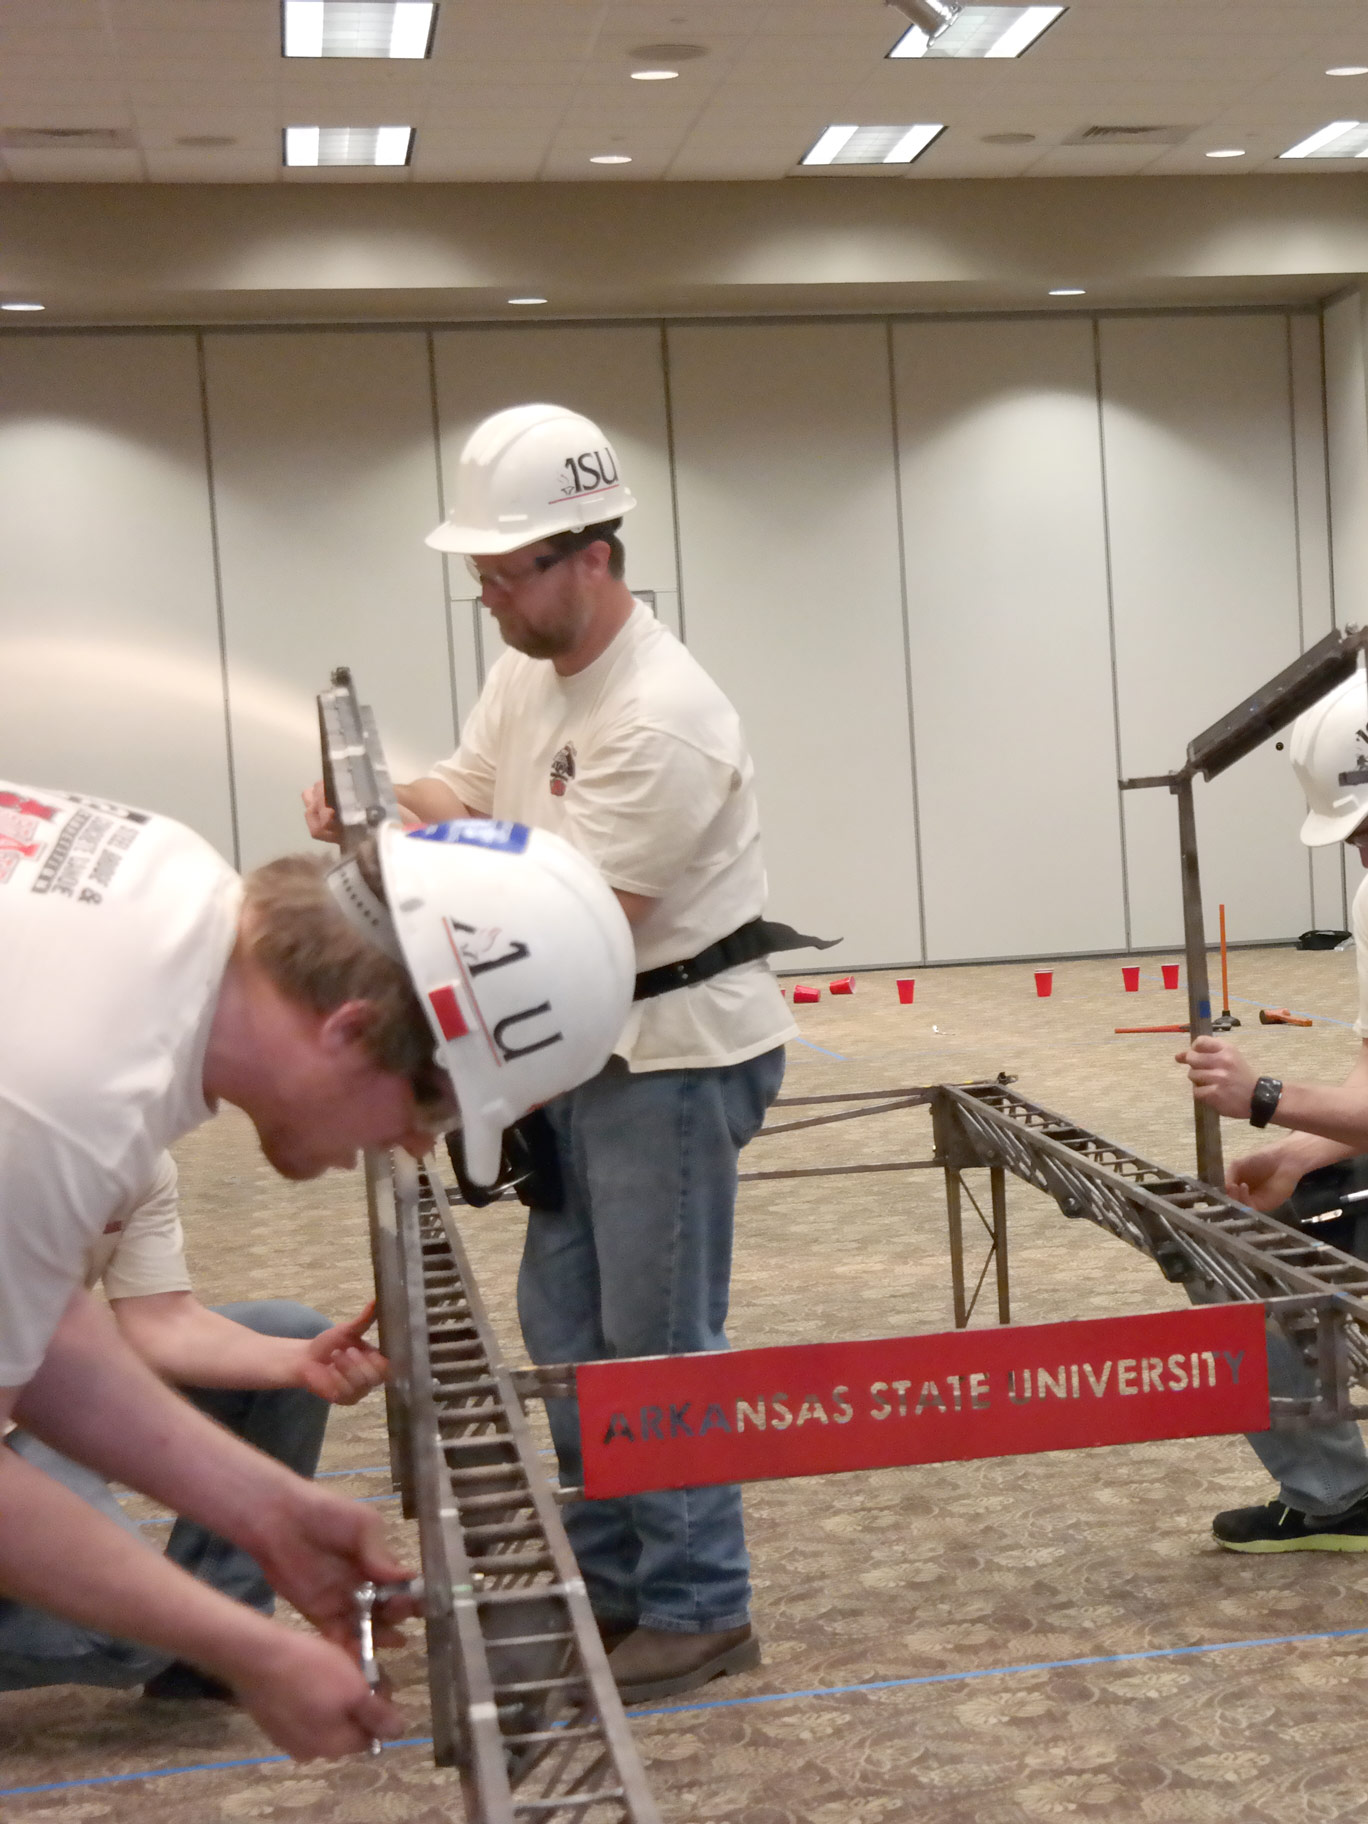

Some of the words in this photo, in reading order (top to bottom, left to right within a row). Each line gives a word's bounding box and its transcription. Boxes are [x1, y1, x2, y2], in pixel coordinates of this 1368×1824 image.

[602, 1384, 855, 1446] ARKANSAS
[869, 1370, 992, 1421] STATE
[1008, 1349, 1247, 1406] UNIVERSITY
